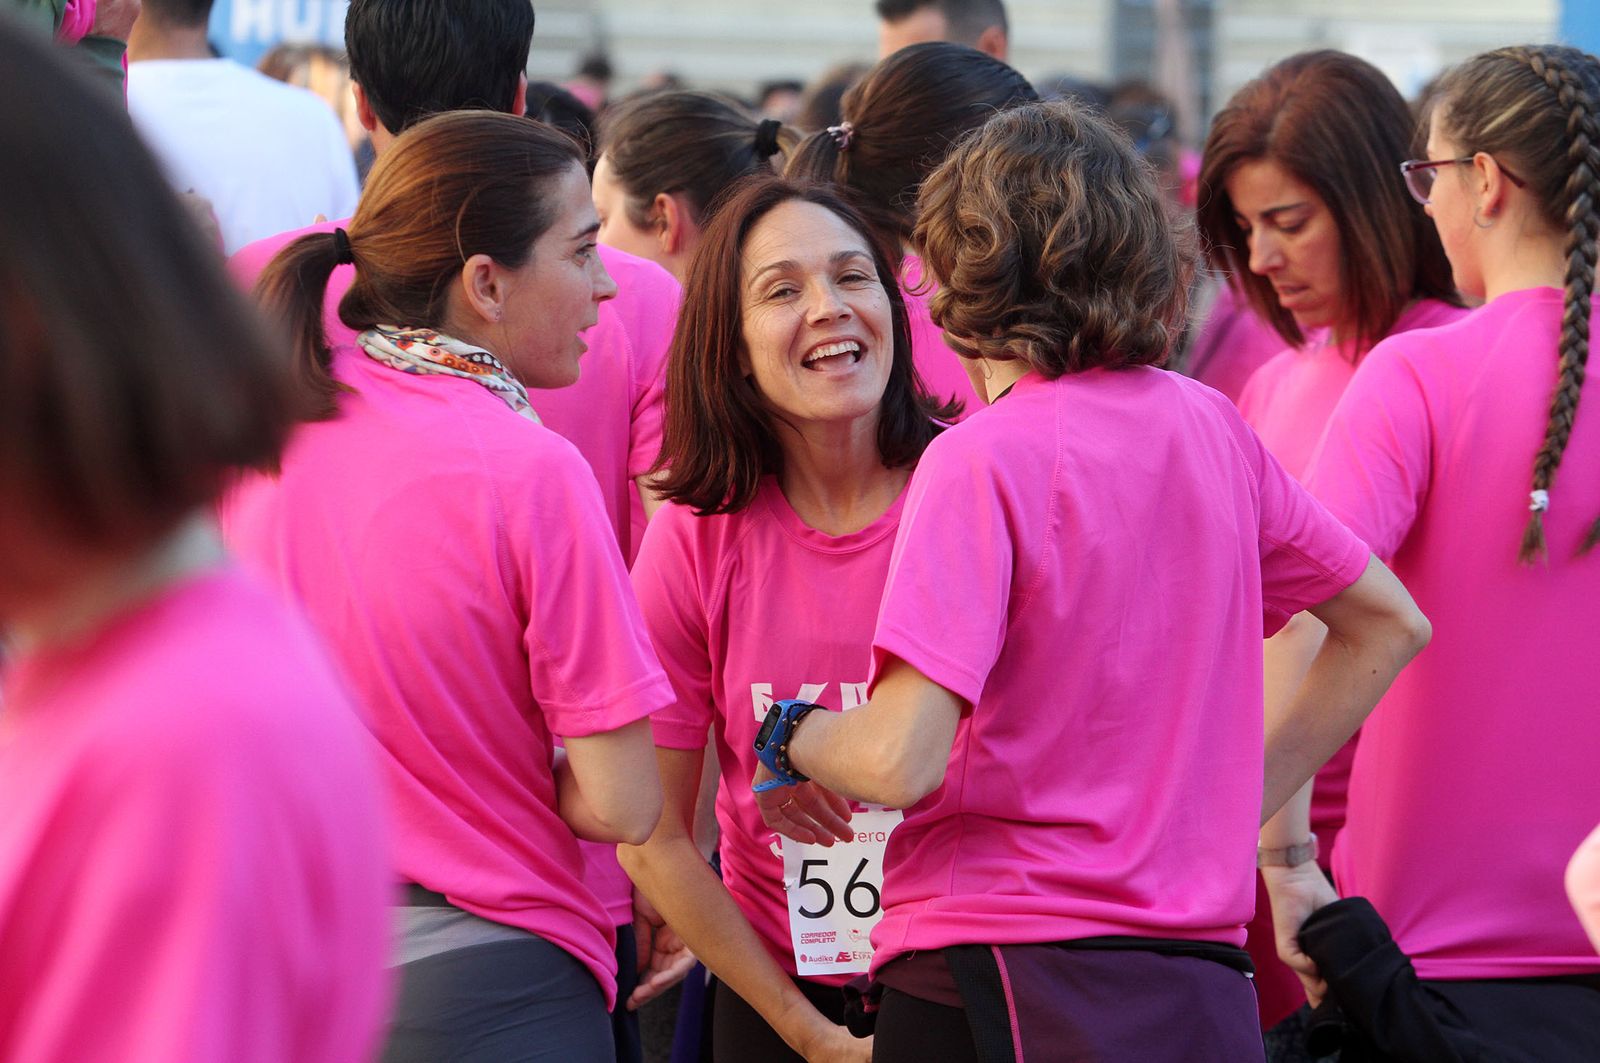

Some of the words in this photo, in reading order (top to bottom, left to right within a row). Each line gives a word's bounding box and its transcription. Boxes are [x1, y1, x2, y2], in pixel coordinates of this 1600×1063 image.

[798, 857, 880, 919] 56
[801, 931, 837, 939] CORREDOR
[808, 954, 833, 963] Audika
